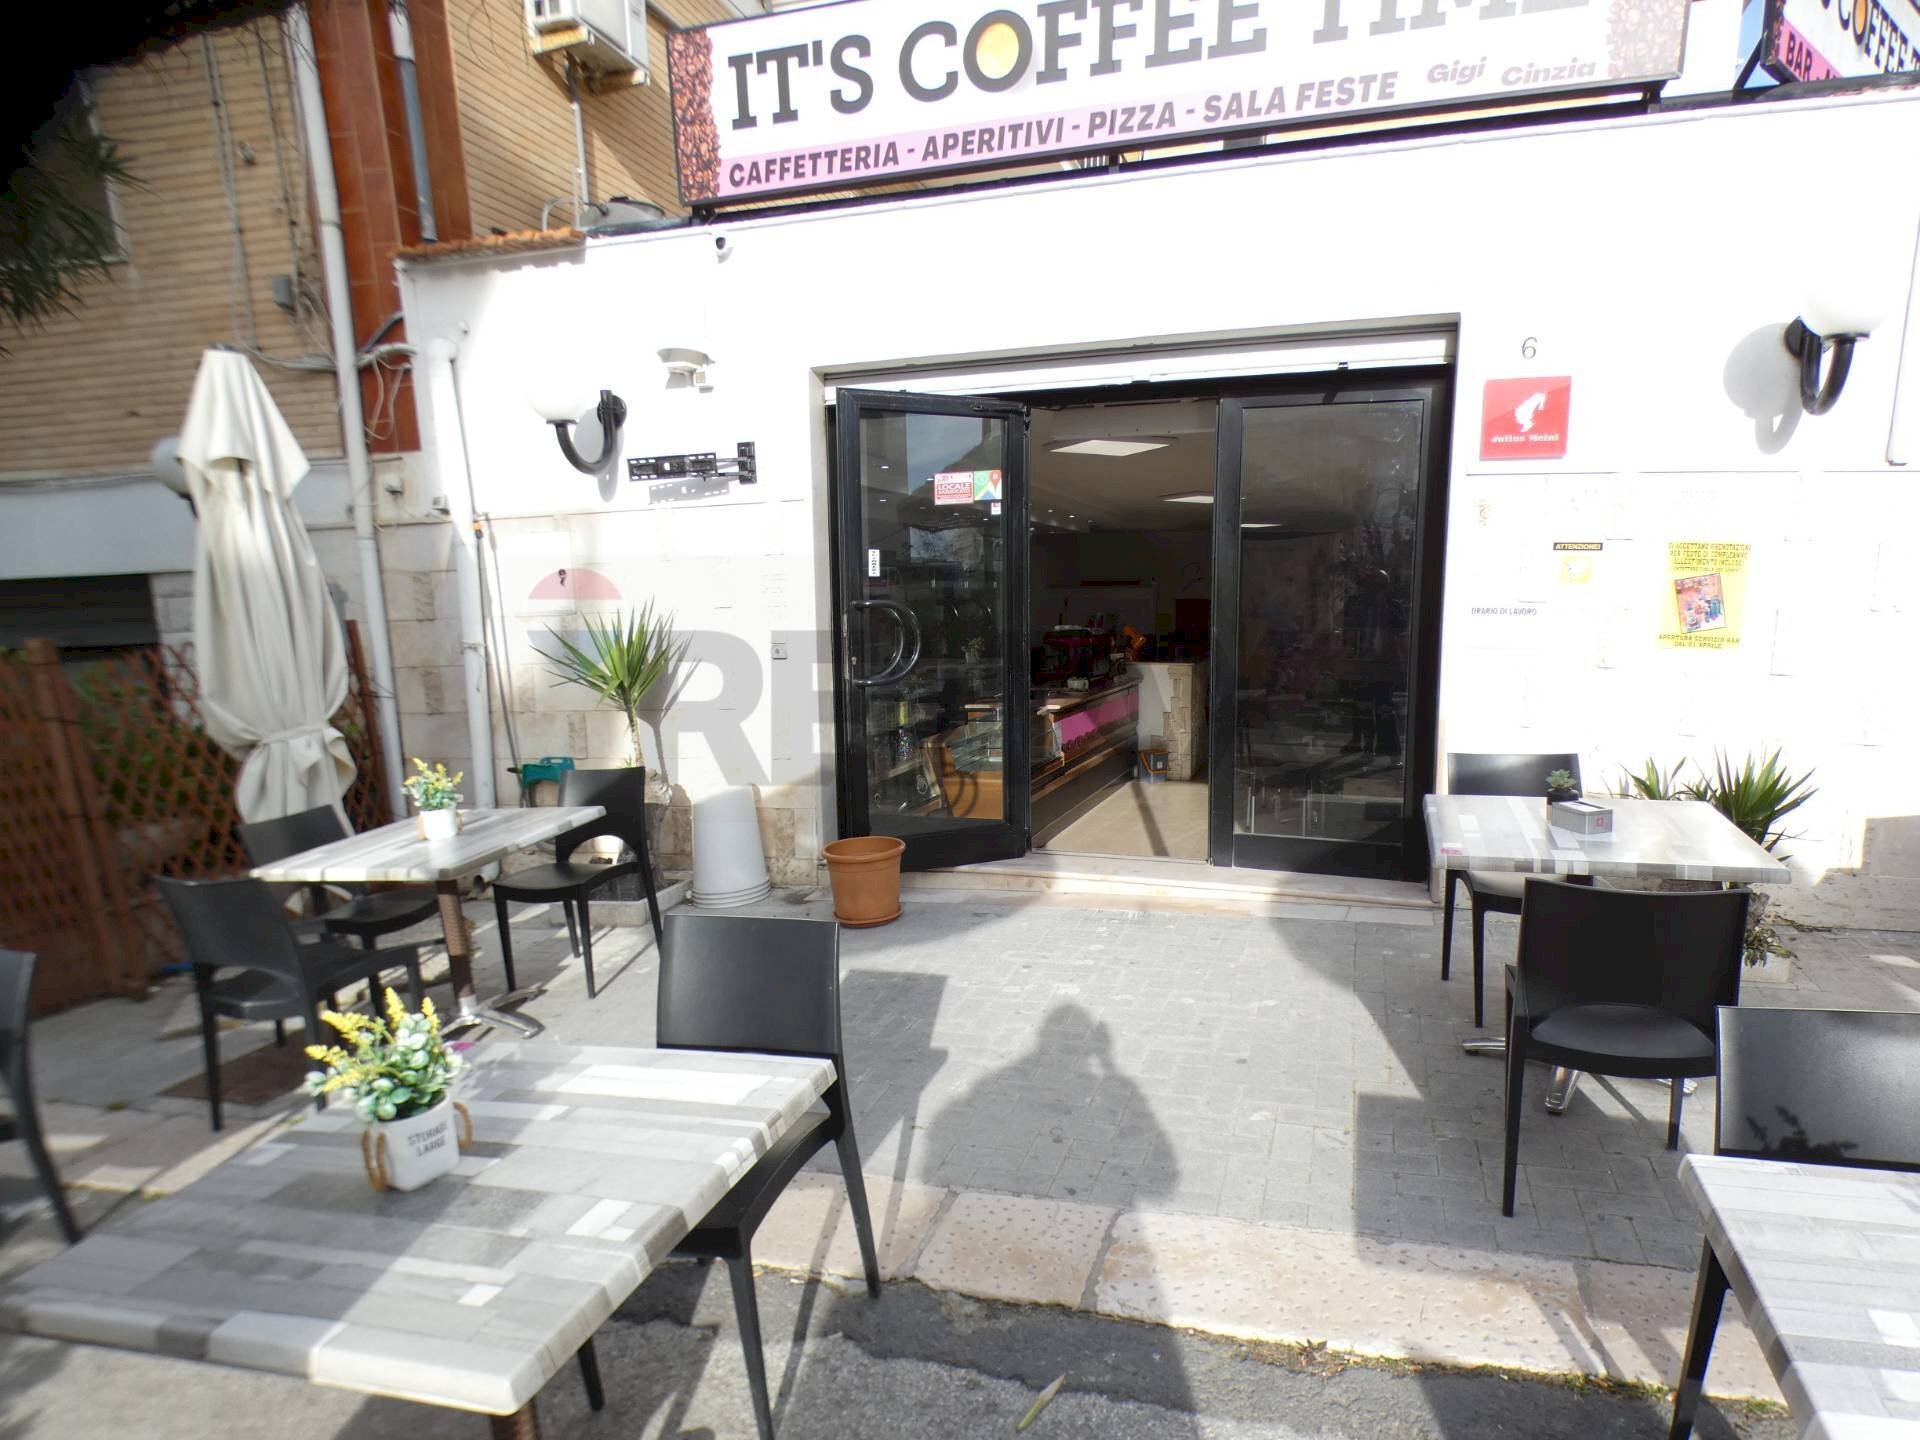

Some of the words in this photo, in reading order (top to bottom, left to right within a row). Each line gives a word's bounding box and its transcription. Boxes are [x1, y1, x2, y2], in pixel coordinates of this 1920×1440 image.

[728, 33, 875, 130] IT'S
[899, 0, 1268, 102] COFFEE
[1785, 31, 1813, 82] BAR
[1427, 56, 1488, 86] Gigi
[1501, 57, 1597, 87] Cinzia
[730, 142, 900, 188] CAFFETTERIA
[921, 117, 1065, 161] APERITIVI
[1087, 100, 1178, 139] PIZZA
[1202, 82, 1293, 123] SALA
[1296, 71, 1399, 111] FESTE
[1521, 336, 1538, 360] 6
[938, 482, 971, 491] LOCALE
[1471, 607, 1498, 615] ORARIO
[1499, 607, 1507, 615] DI
[1509, 607, 1537, 616] LAVORO
[1658, 633, 1693, 641] APERTURA
